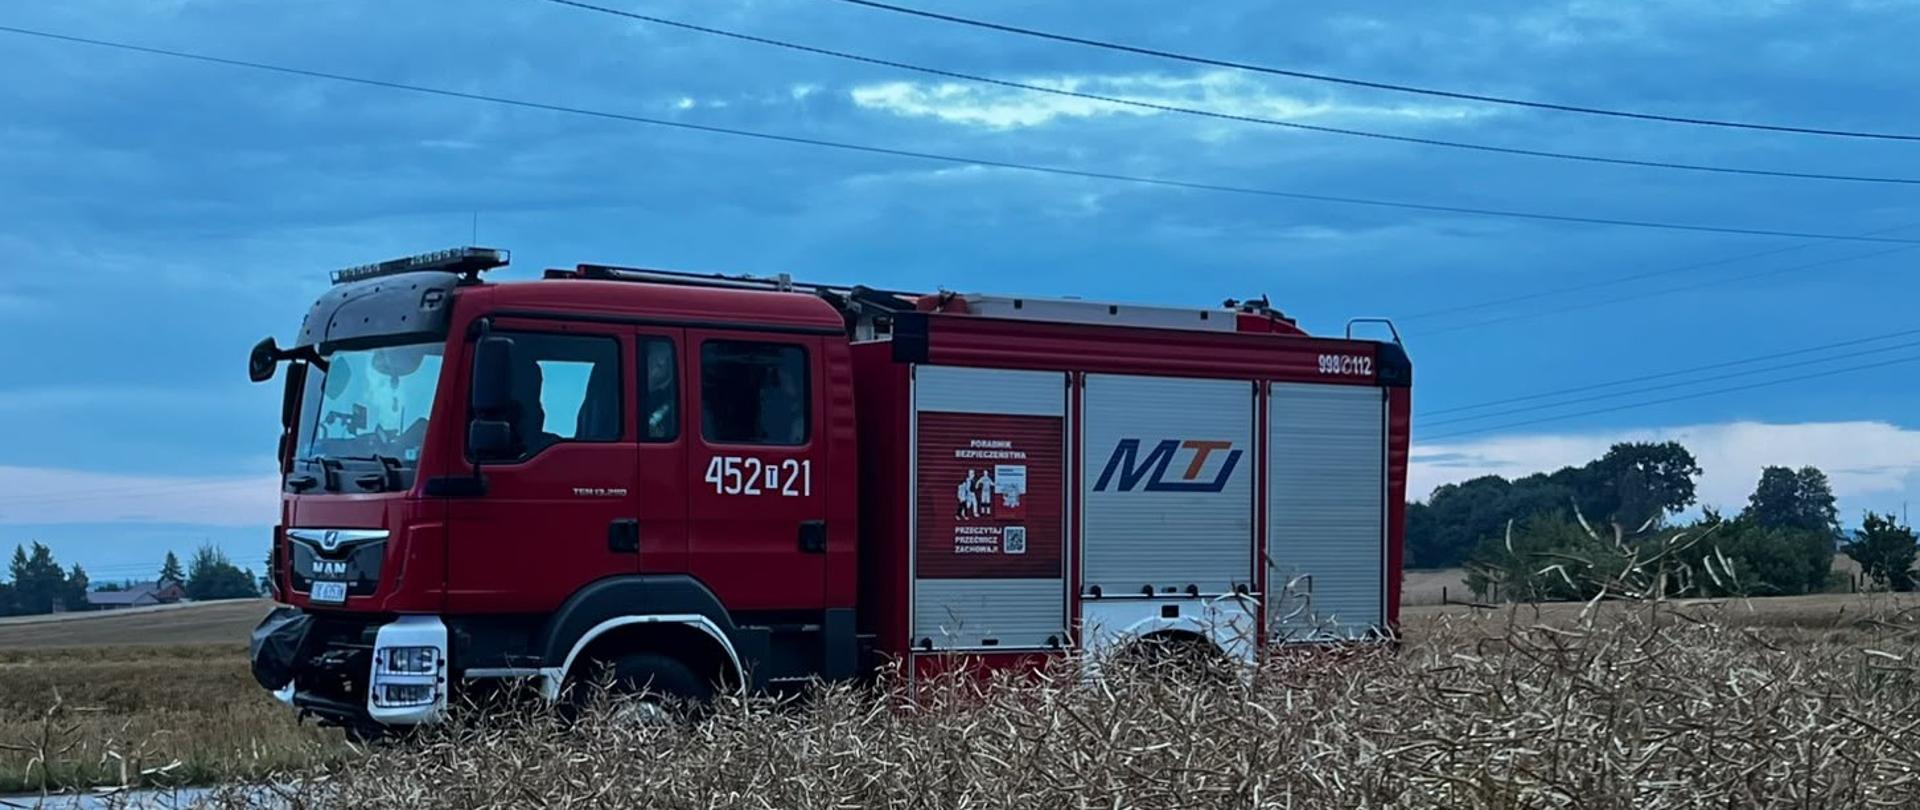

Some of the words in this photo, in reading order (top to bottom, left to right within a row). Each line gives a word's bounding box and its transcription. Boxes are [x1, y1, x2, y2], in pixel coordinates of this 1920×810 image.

[1318, 354, 1340, 374] 998
[1352, 356, 1372, 375] 112
[970, 440, 1012, 448] PORADNIK
[705, 456, 761, 495] 452
[782, 459, 810, 497] 21
[955, 526, 1002, 535] PRZECZYTAJ
[312, 562, 347, 574] MAN
